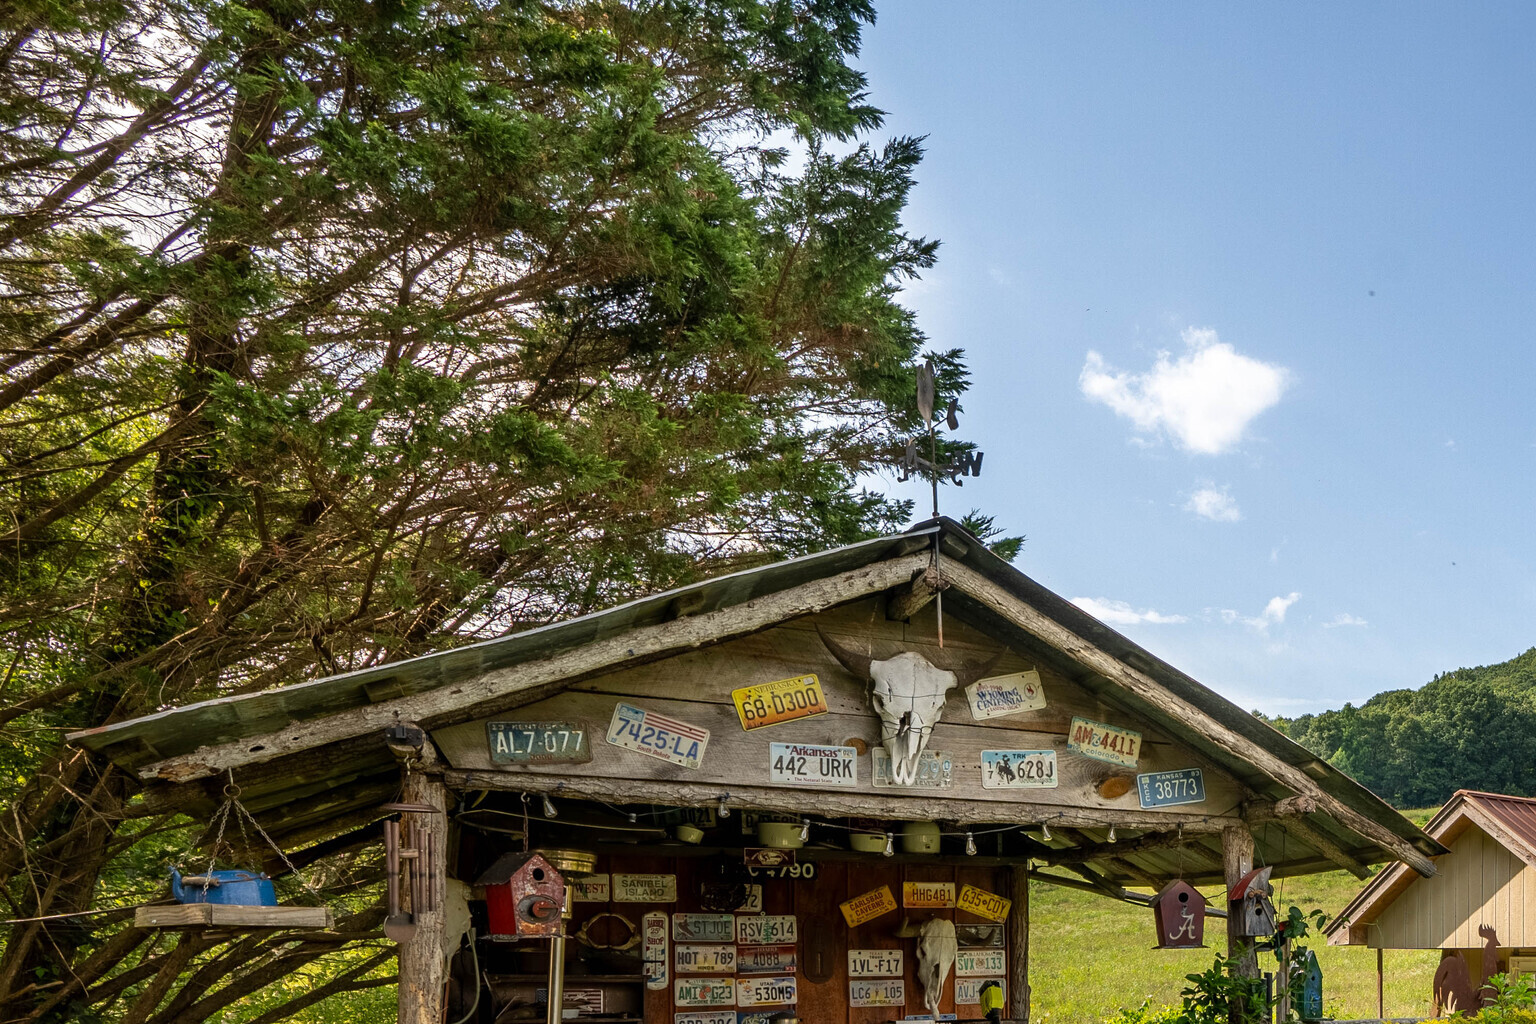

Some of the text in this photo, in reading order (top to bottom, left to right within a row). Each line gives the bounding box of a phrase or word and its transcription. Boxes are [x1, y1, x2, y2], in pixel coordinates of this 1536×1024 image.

[753, 680, 798, 694] NEBRASKA
[976, 686, 1019, 700] WYOMING
[976, 695, 1026, 711] CENTENNIAL
[637, 745, 671, 759] South Dakota
[789, 745, 838, 758] Arkansas
[1085, 749, 1120, 760] colorado
[773, 755, 807, 776] 442
[820, 758, 853, 778] URK
[1017, 760, 1053, 778] 628J
[1156, 772, 1184, 780] KANSAS
[1155, 778, 1197, 800] 38773
[575, 883, 606, 894] WEST
[621, 879, 668, 888] SANIBEL
[625, 888, 665, 897] ISLAND
[850, 891, 884, 911] CARLSBAD
[855, 898, 885, 917] CAVERNS
[740, 921, 794, 937] RSV 614
[647, 936, 664, 945] SHOP
[713, 951, 734, 965] 789
[957, 957, 1002, 971] SVX 133
[711, 985, 732, 1000] G23
